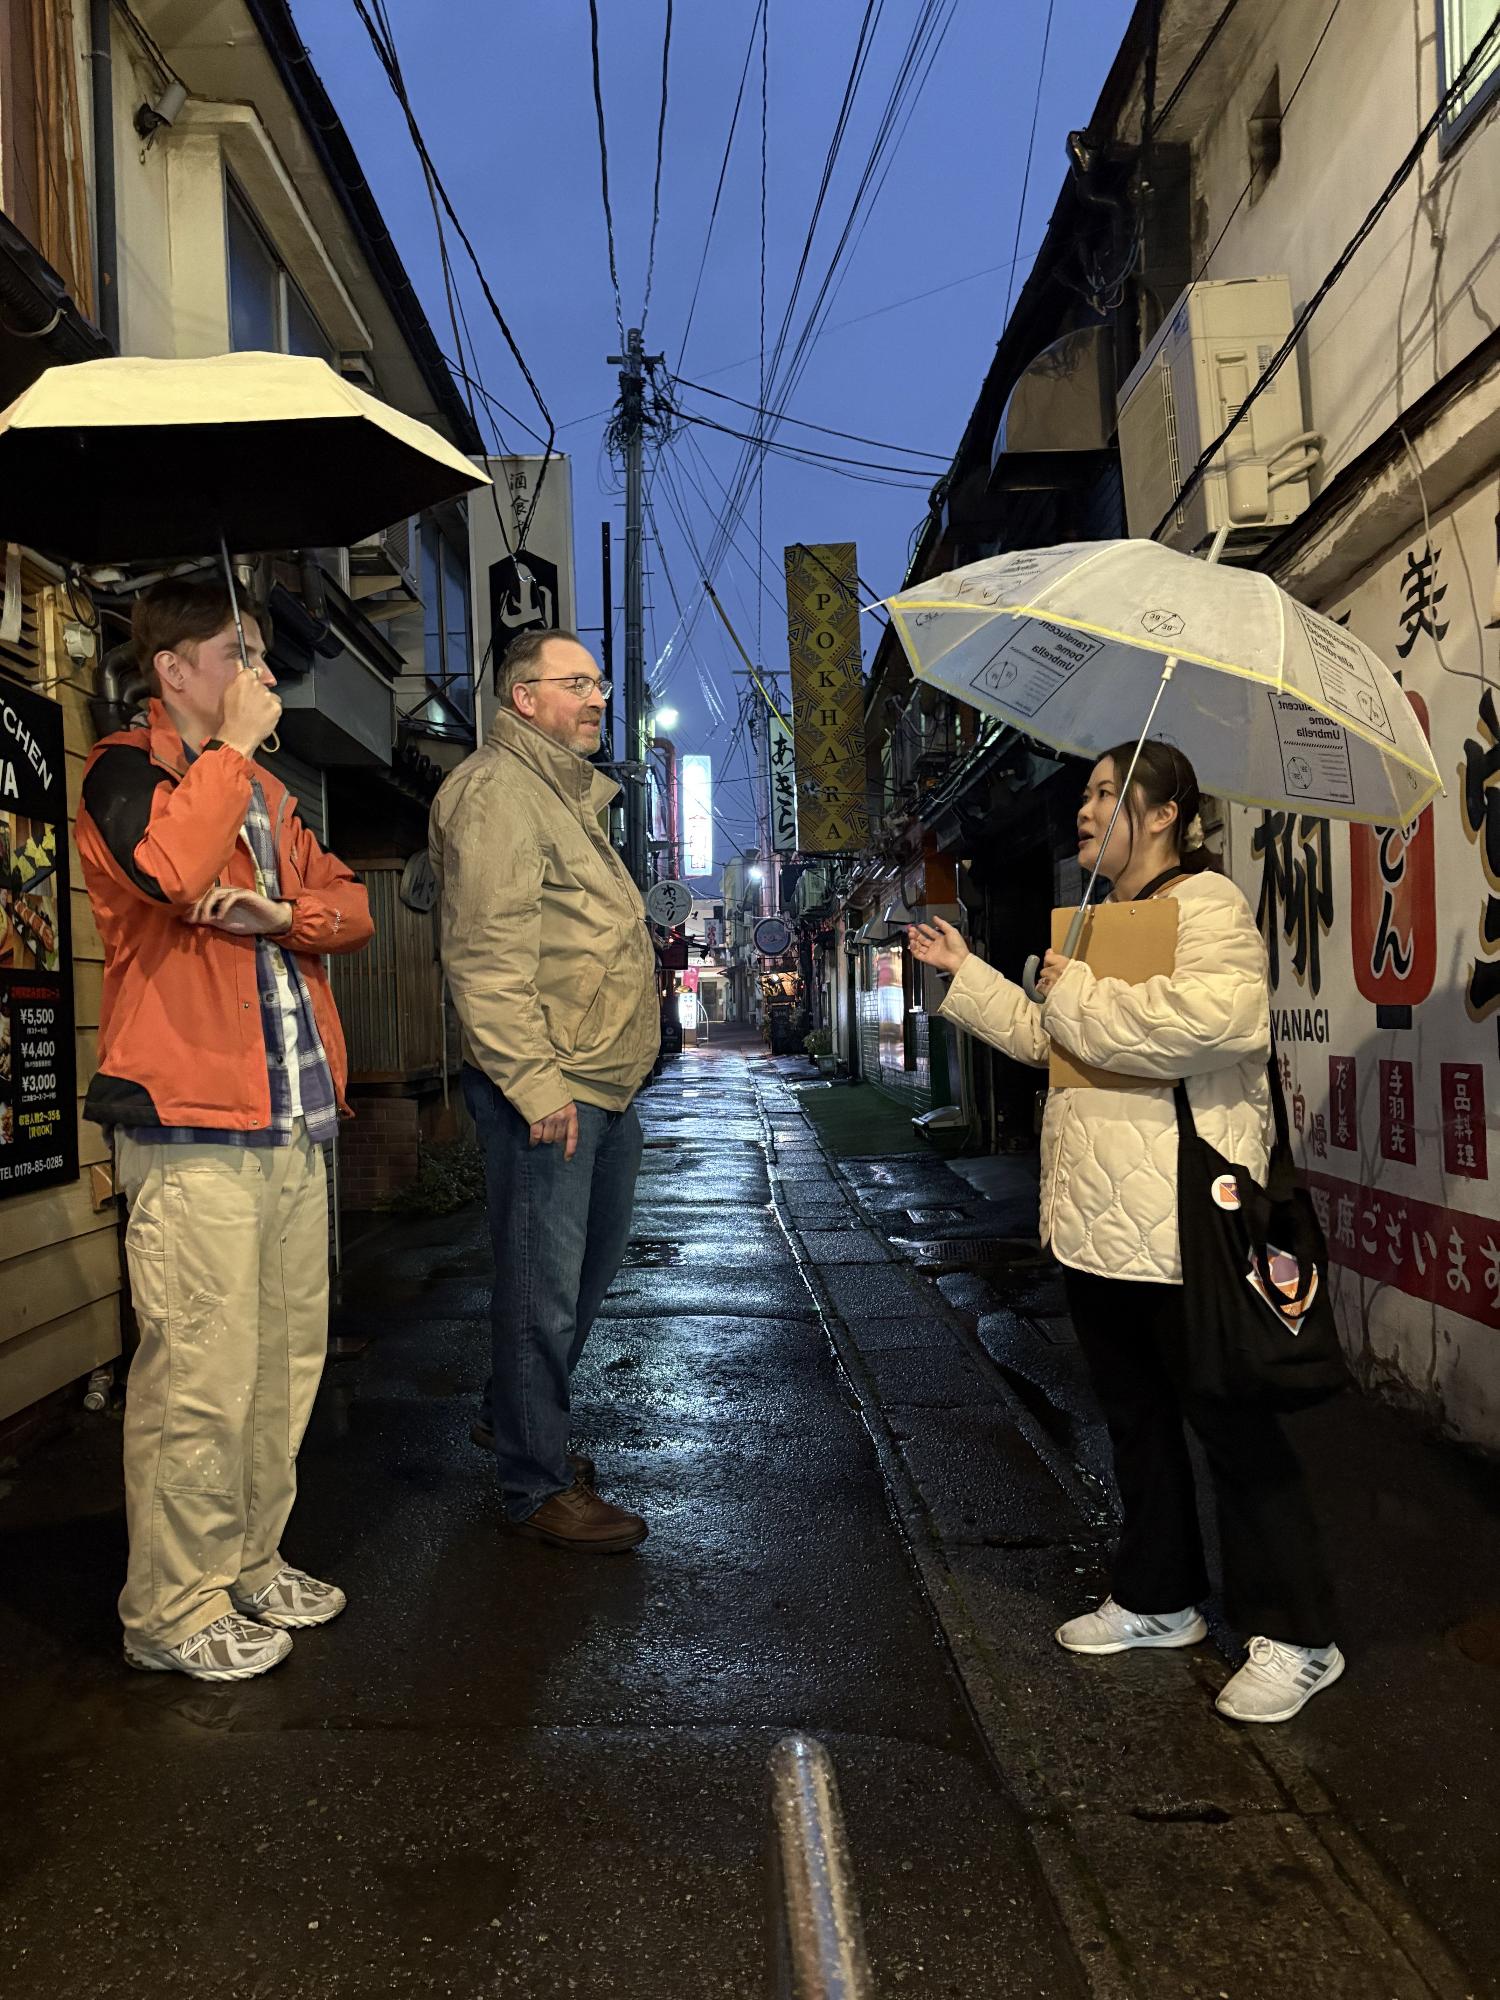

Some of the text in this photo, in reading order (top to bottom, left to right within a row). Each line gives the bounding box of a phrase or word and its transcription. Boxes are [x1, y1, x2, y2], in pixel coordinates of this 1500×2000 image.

[815, 593, 842, 840] POKHARA
[20, 1008, 54, 1026] ¥5,500
[21, 1041, 55, 1059] ¥4,400
[22, 1073, 56, 1093] ¥3,000
[1335, 1061, 1351, 1144] だし巻
[1388, 1065, 1406, 1154] 手羽先
[1453, 1071, 1477, 1168] 一品料理
[0, 1155, 64, 1180] TEL 0178-85-0285
